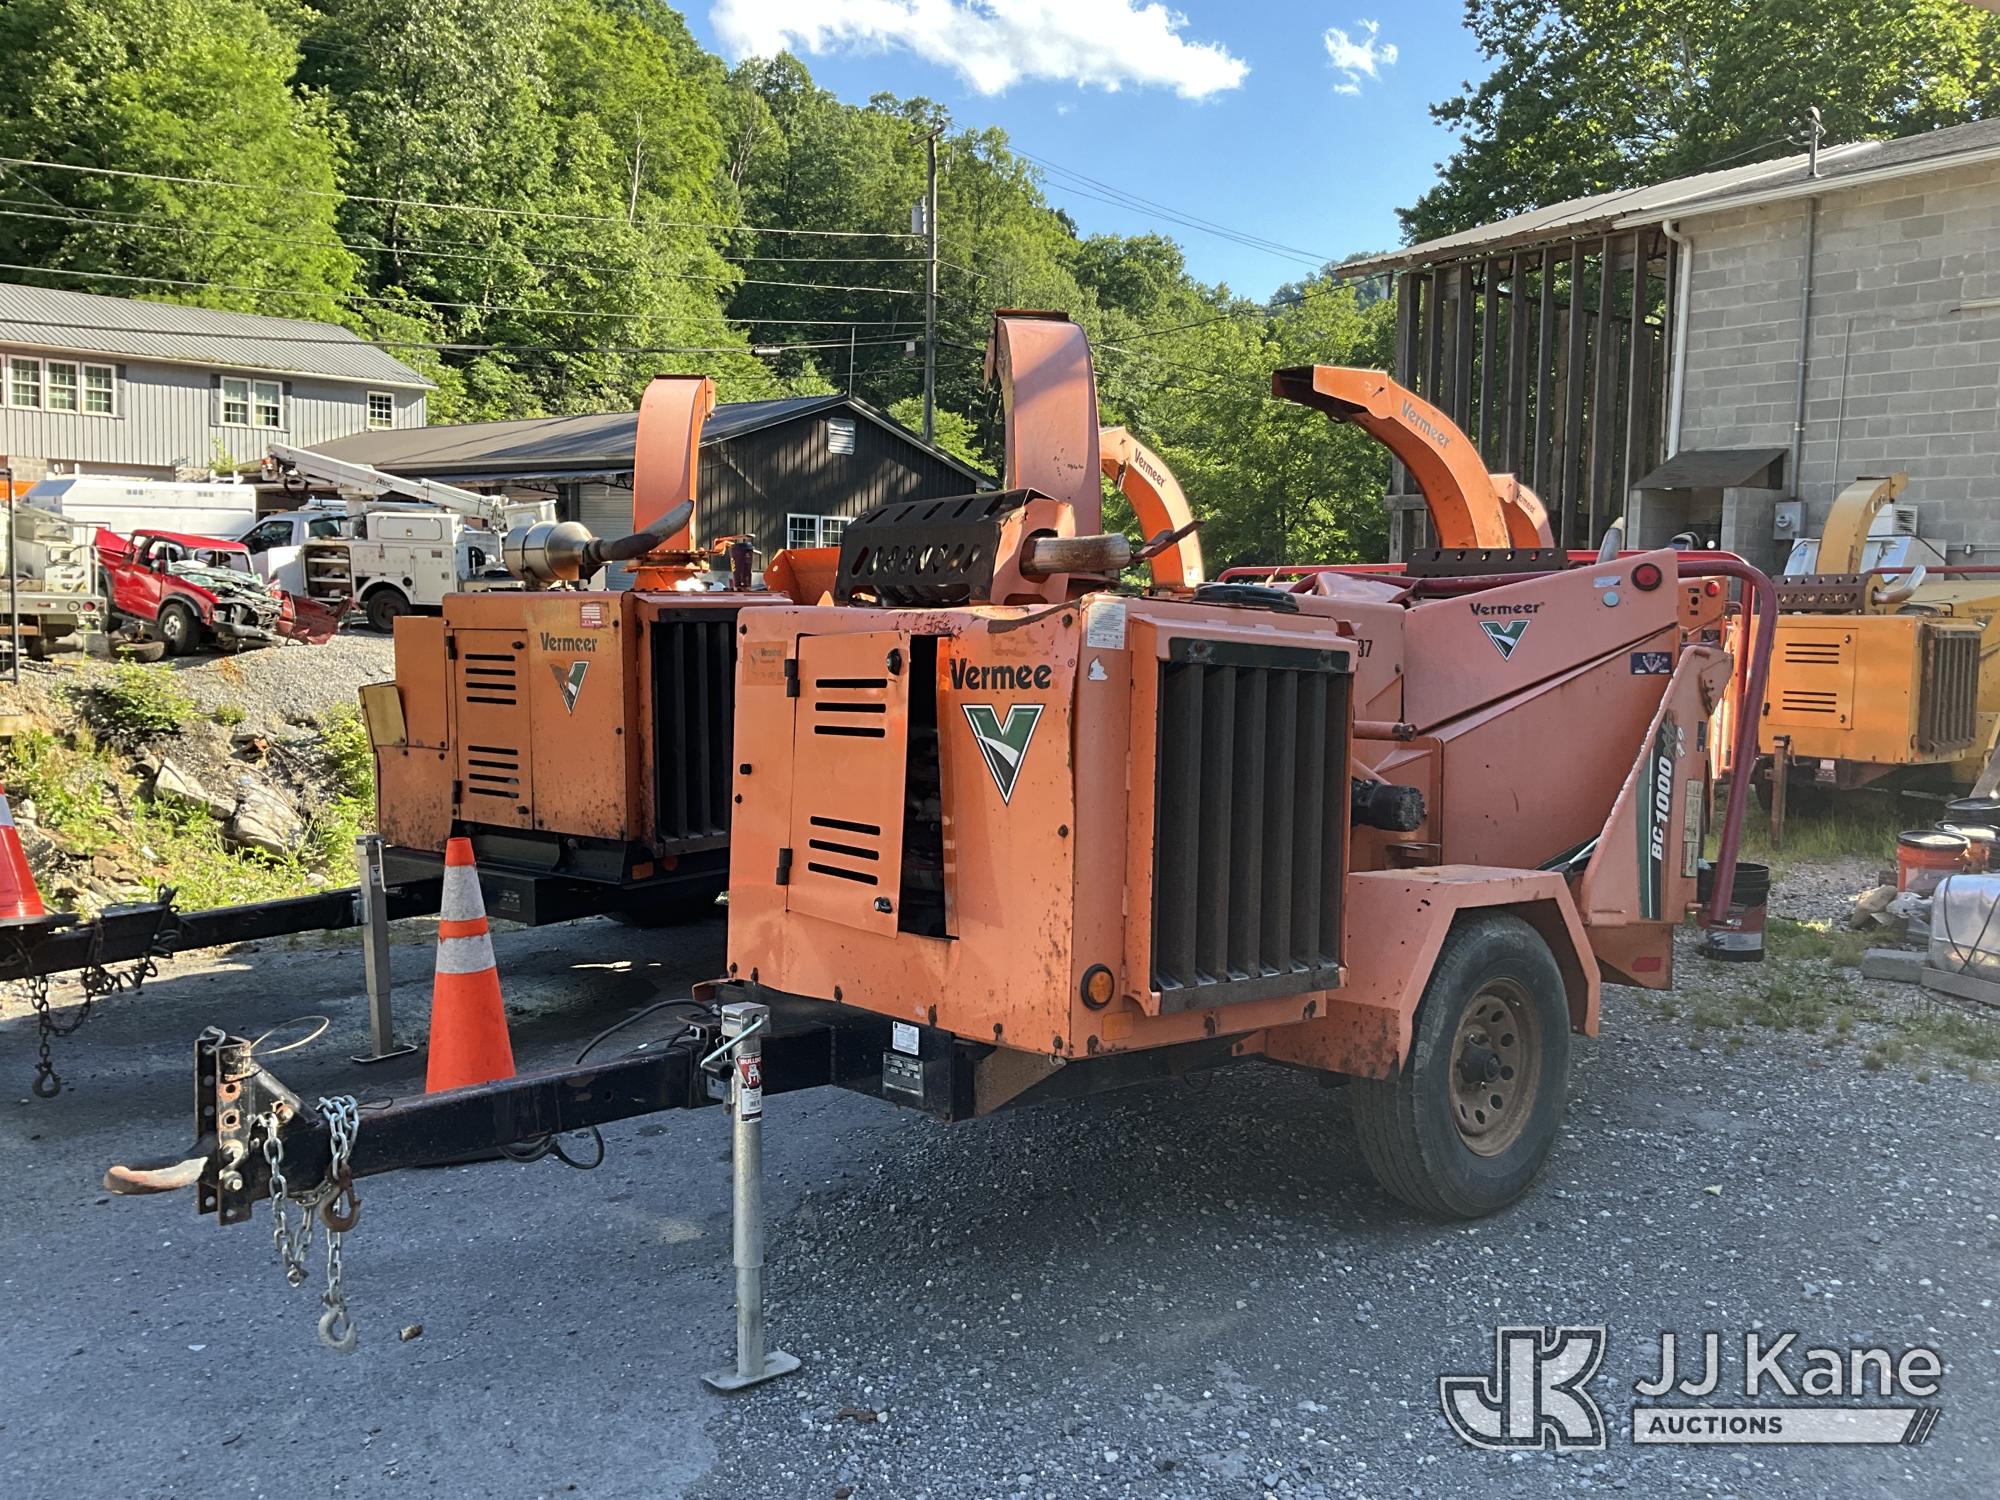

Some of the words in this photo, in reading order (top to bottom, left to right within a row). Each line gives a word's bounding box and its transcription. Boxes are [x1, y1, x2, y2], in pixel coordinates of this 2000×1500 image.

[1401, 399, 1451, 449] Vermeer
[1135, 447, 1165, 488] Vermeer
[1470, 602, 1541, 616] Vermeer
[1655, 756, 1672, 823] 1000
[1651, 826, 1664, 861] BC
